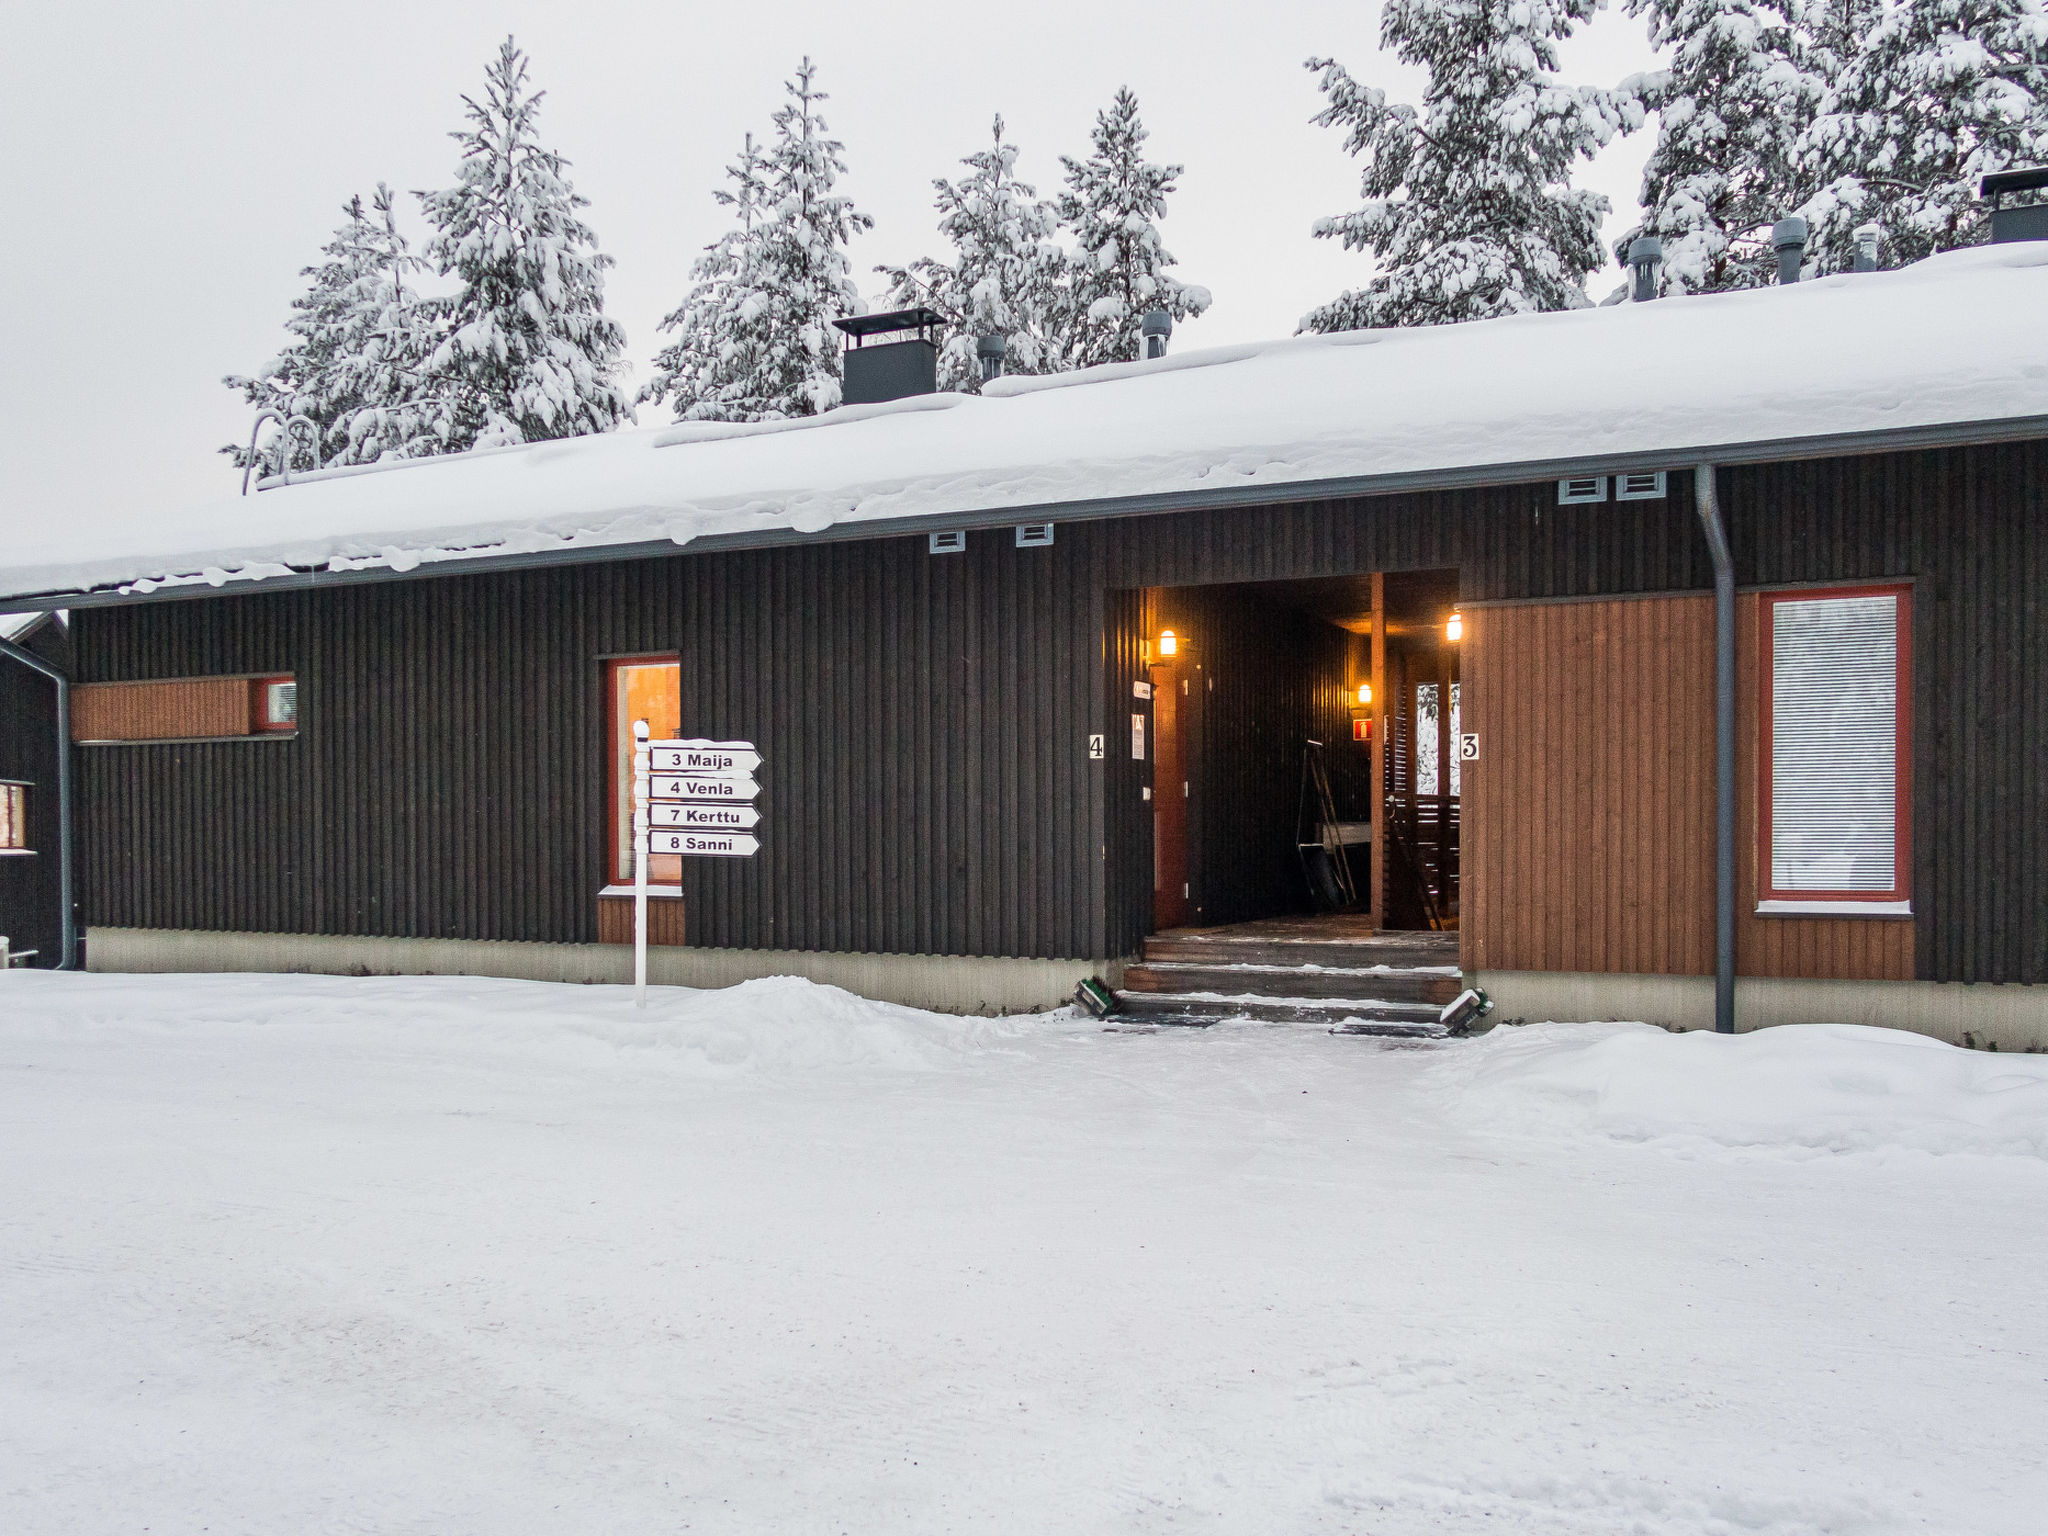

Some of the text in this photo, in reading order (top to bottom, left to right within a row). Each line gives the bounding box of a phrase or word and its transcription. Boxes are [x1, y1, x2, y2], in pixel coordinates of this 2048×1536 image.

[1090, 736, 1102, 756] 4
[1463, 735, 1477, 757] 3
[672, 753, 733, 770] 3 Maija
[670, 782, 733, 795] 4 Venla
[670, 809, 740, 824] 7 Kerttu
[670, 837, 732, 851] 8 Sanni
